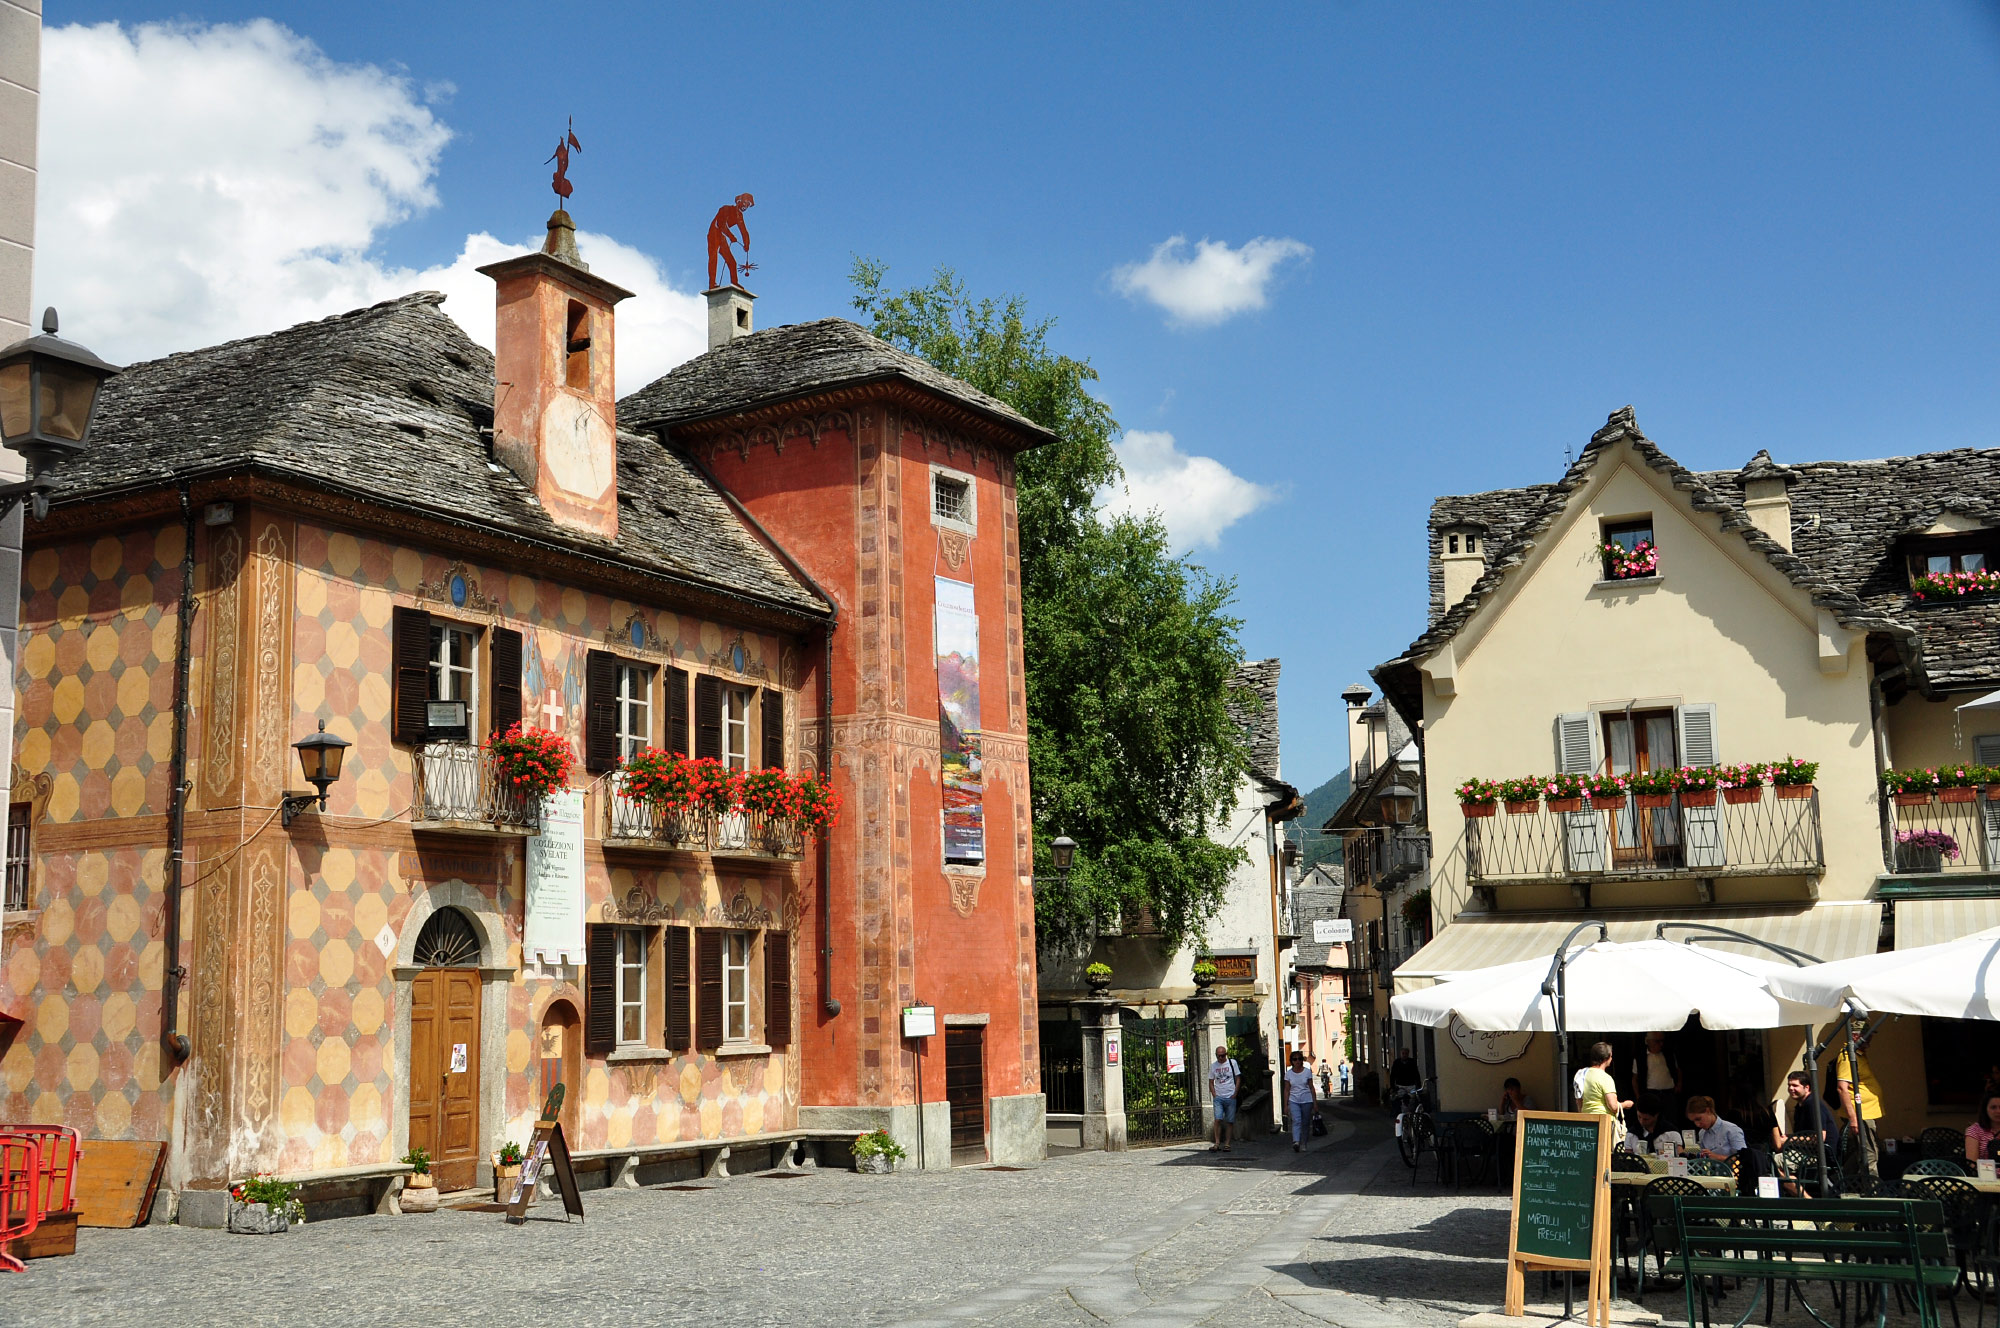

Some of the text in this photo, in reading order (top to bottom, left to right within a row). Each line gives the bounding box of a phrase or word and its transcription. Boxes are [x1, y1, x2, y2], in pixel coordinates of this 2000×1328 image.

[533, 839, 574, 851] COLLEZIONI
[540, 850, 568, 860] SVELATE
[1323, 927, 1350, 935] Colonne
[383, 934, 389, 947] 9
[1573, 1140, 1597, 1152] TOAST
[1540, 1148, 1580, 1159] INSALATONE
